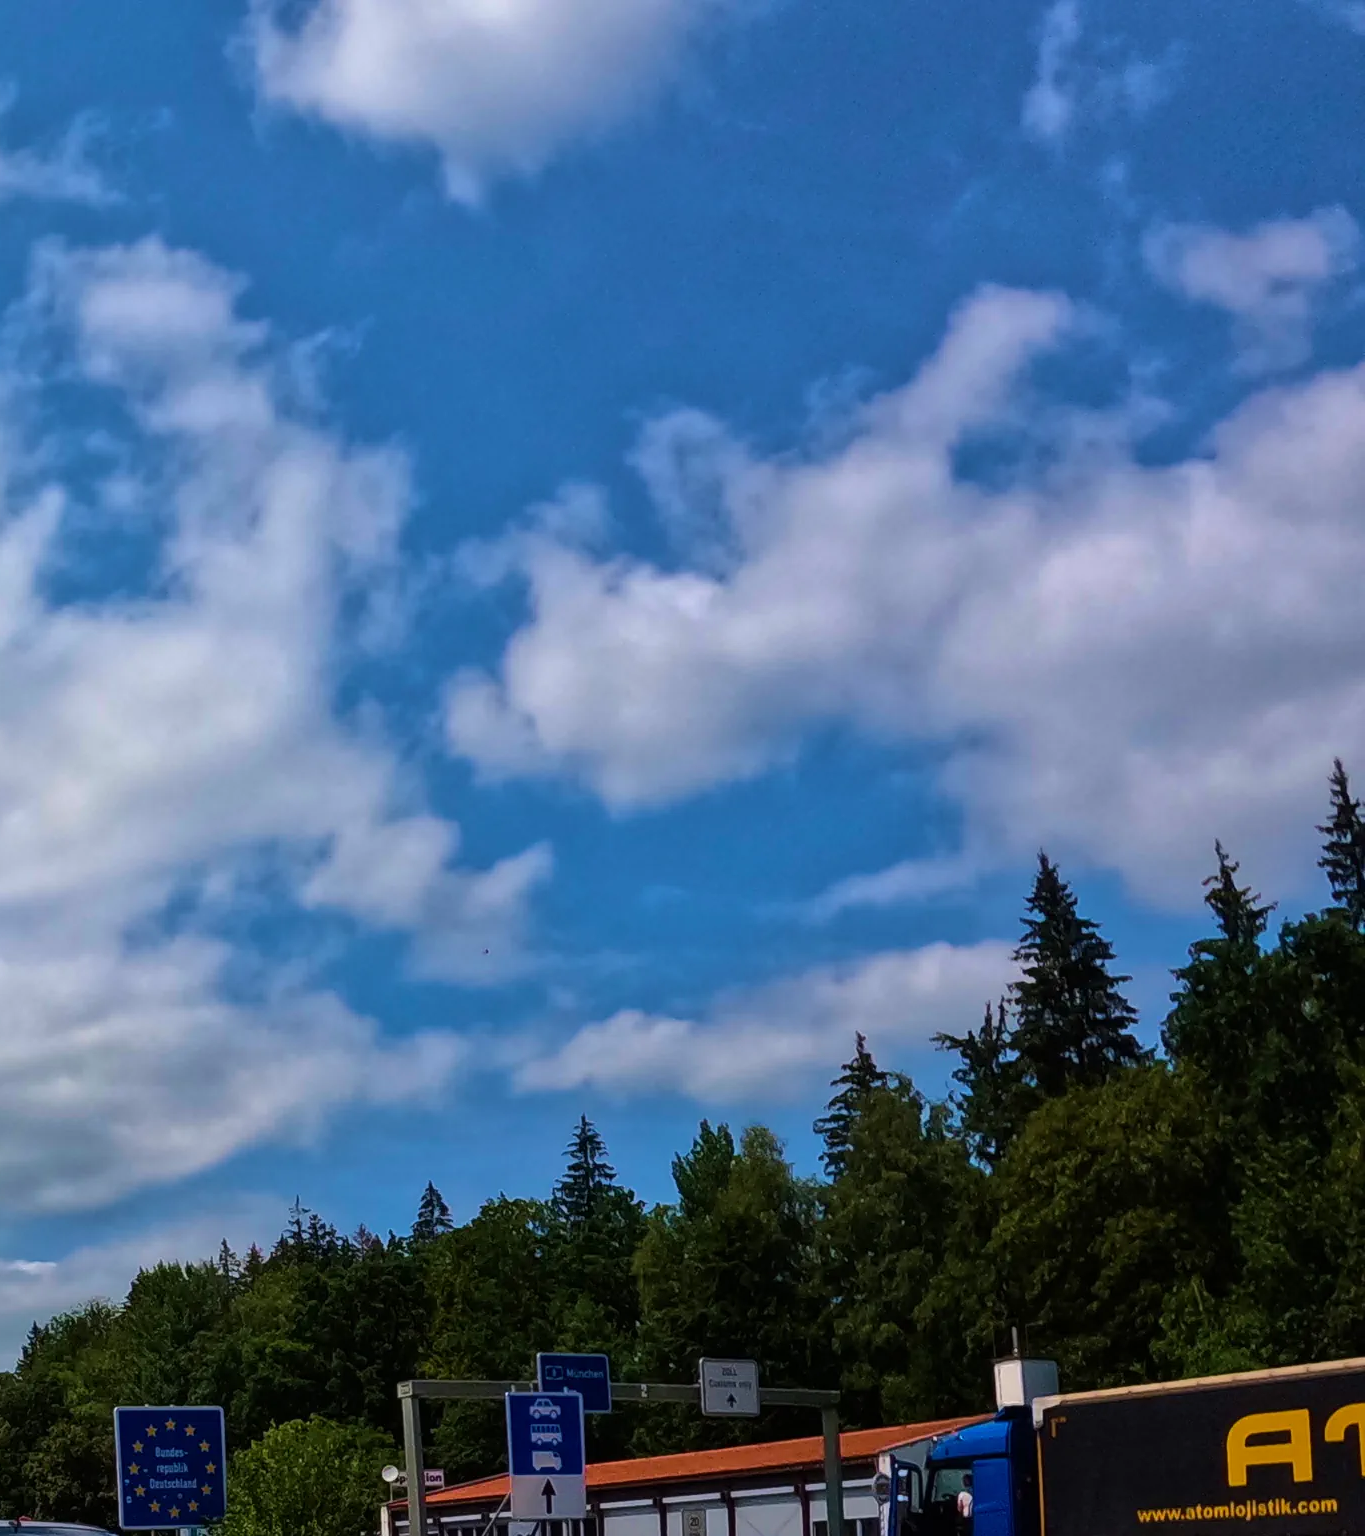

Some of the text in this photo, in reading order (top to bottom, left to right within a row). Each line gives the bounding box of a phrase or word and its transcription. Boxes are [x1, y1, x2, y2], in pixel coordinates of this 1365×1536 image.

[155, 1446, 189, 1458] Bundes-
[156, 1462, 189, 1476] republik
[149, 1478, 198, 1489] Deutschland
[1136, 1498, 1339, 1524] www.atomlojistik.com
